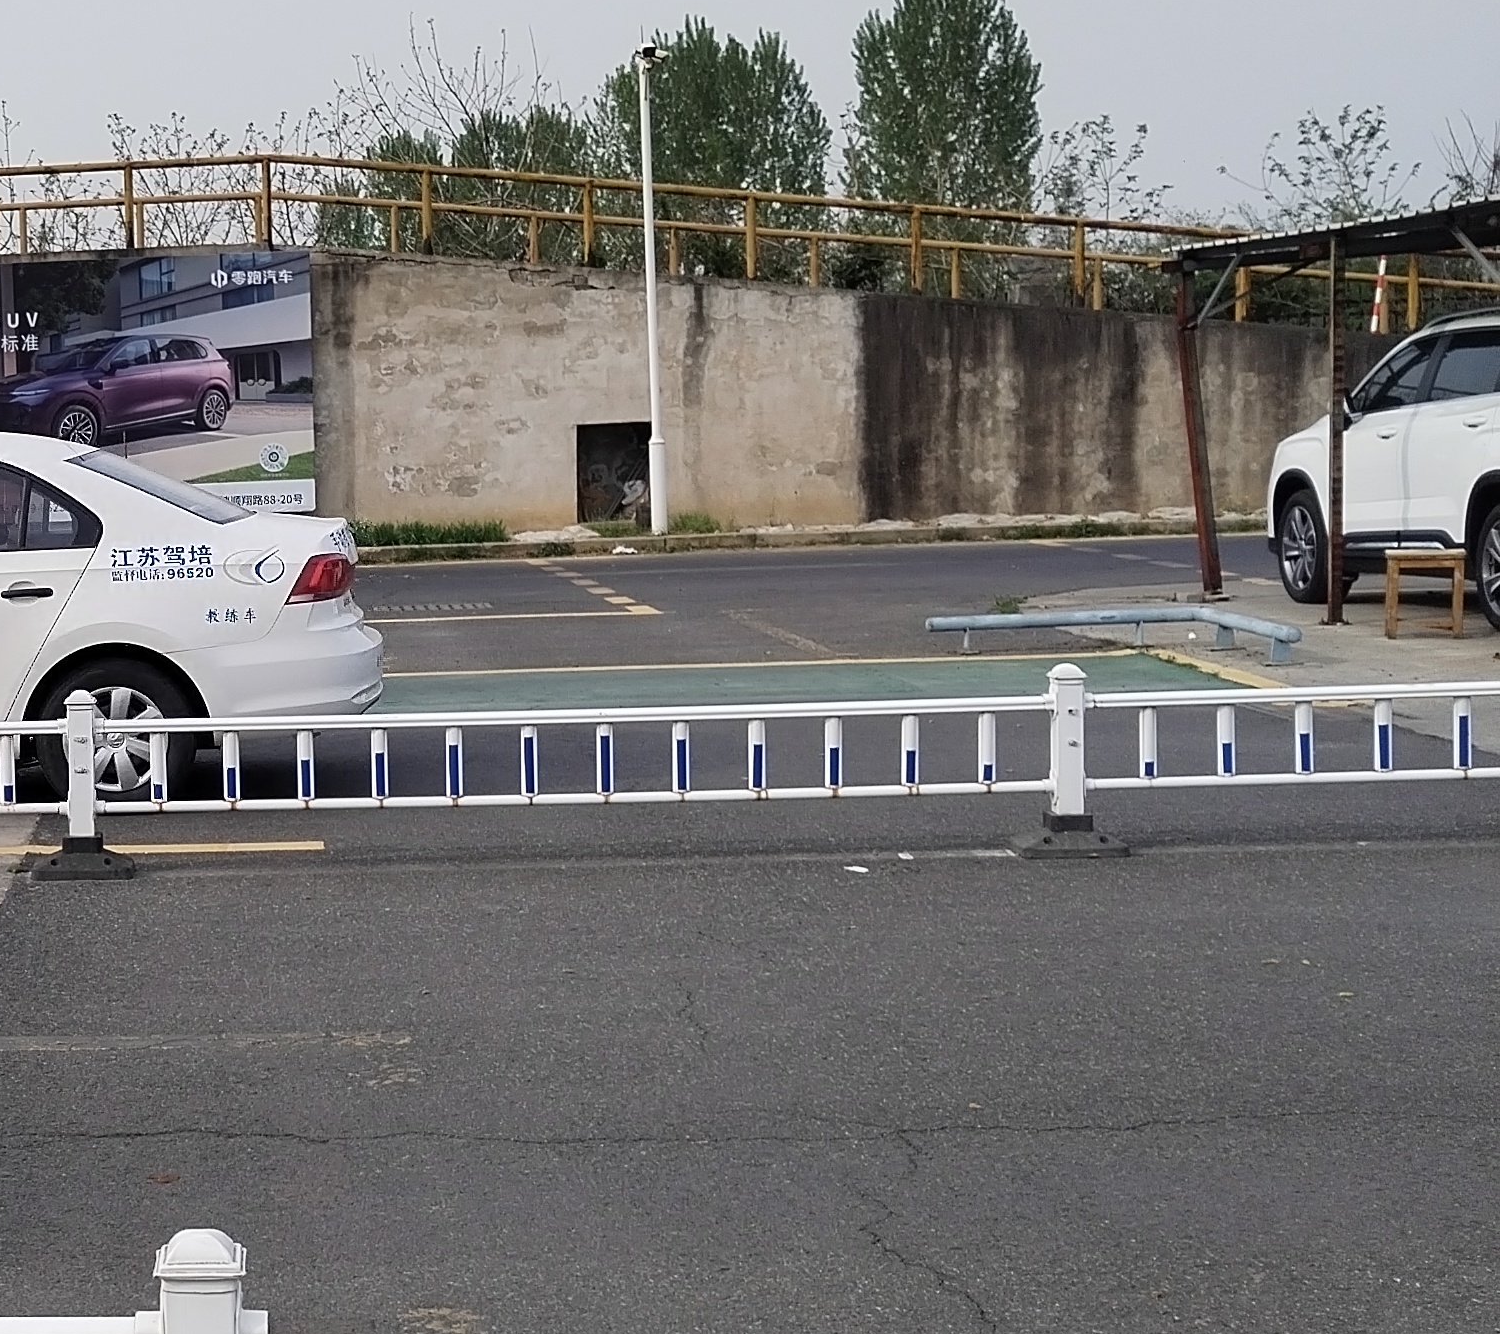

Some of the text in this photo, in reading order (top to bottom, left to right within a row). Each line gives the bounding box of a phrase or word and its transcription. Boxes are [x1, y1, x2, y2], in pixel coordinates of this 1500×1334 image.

[231, 269, 293, 285] 零跑汽车
[111, 544, 213, 568] 江苏驾培
[205, 607, 257, 624] 教练车
